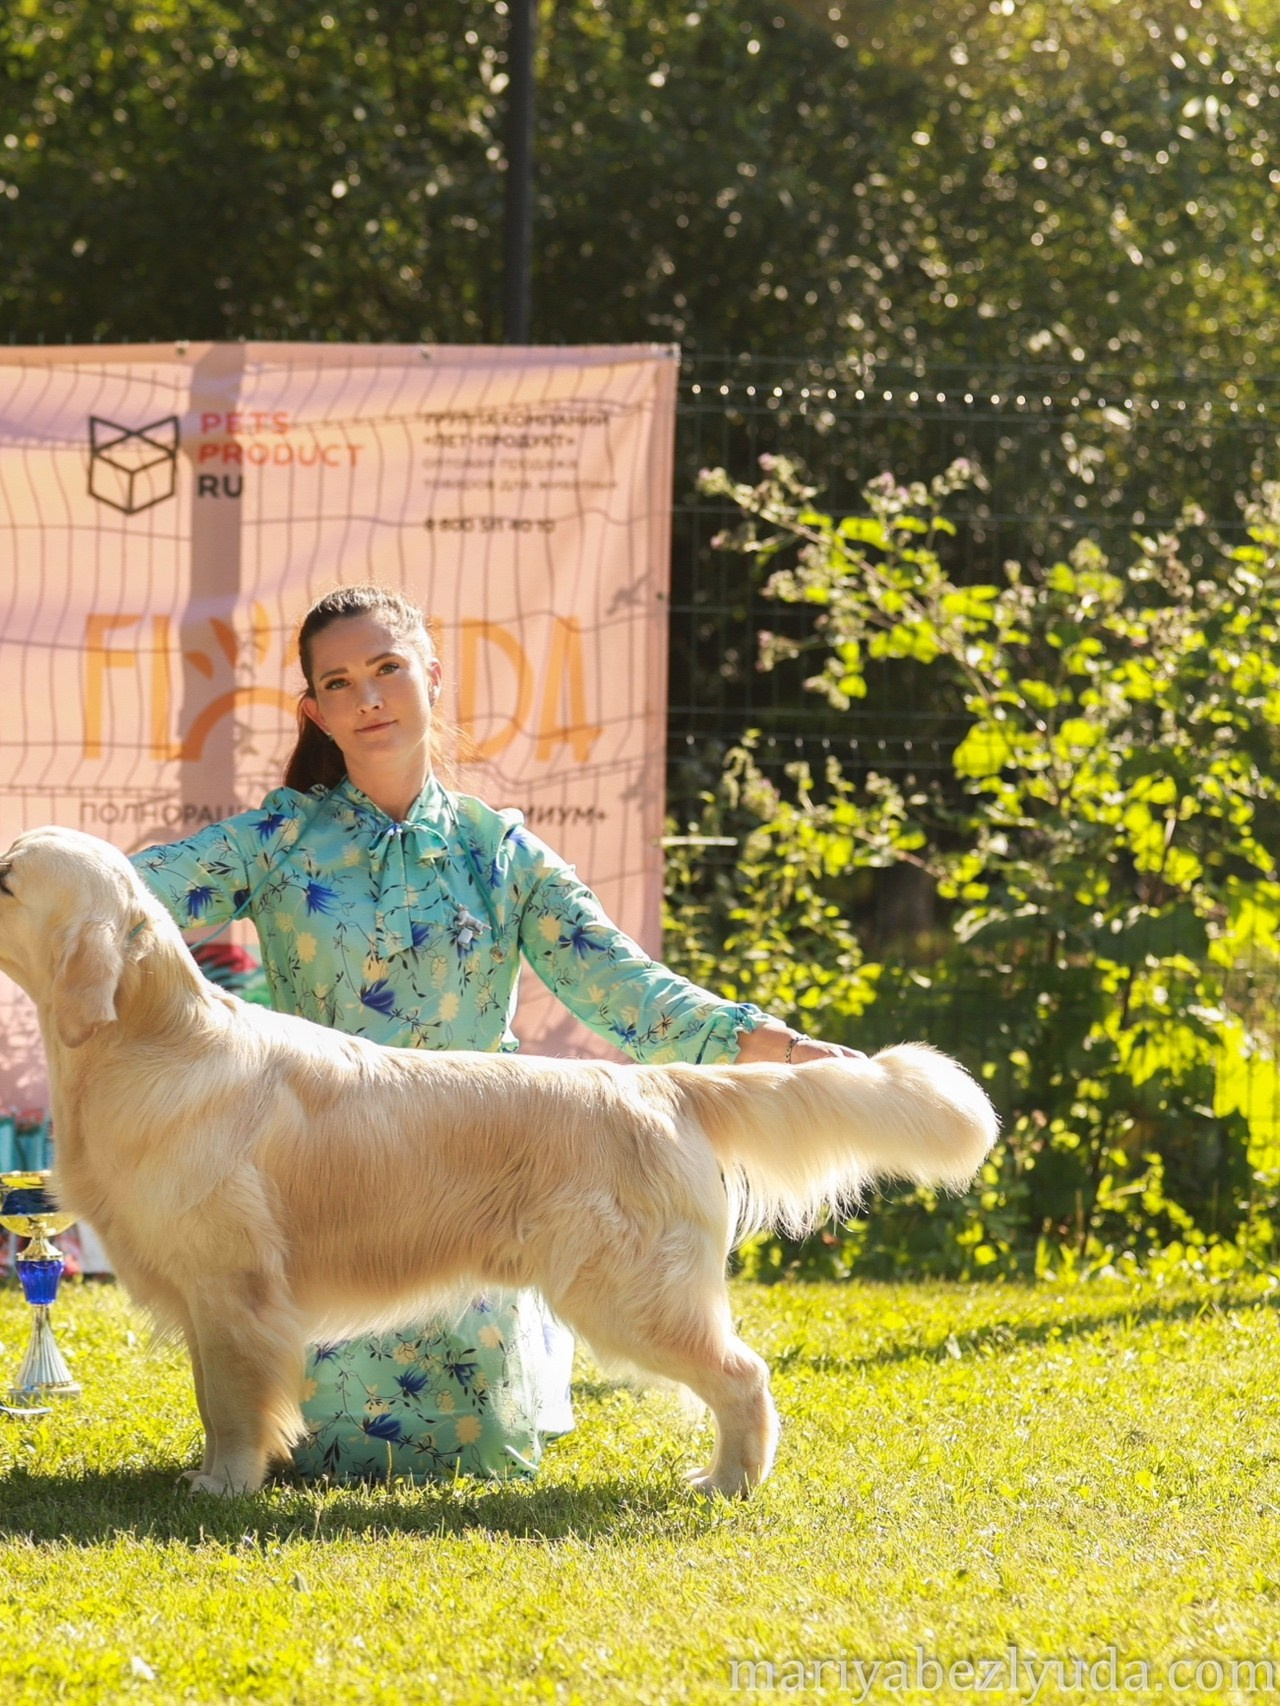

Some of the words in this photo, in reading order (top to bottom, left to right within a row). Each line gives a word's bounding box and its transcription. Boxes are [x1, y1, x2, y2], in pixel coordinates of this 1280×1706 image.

[201, 411, 291, 434] PETS
[197, 444, 365, 467] PRODUCT
[197, 474, 243, 498] RU
